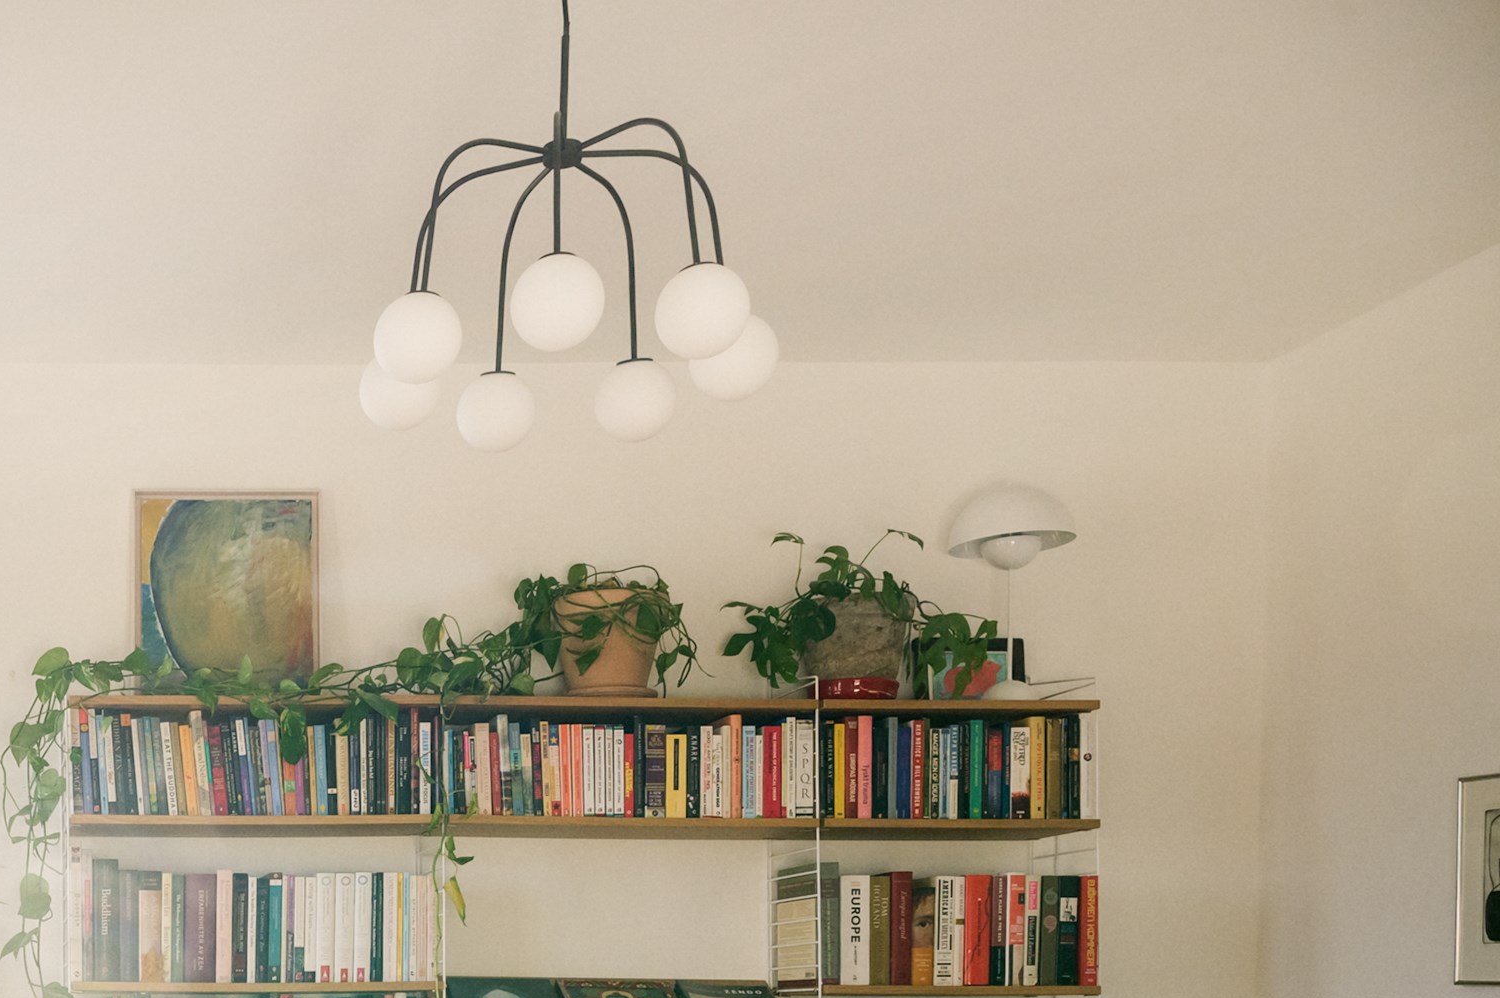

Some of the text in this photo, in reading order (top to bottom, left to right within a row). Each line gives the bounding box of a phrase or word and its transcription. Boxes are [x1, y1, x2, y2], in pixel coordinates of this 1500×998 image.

[690, 735, 698, 762] KNARK
[861, 764, 870, 782] Tyskt
[932, 773, 938, 782] OF
[167, 774, 176, 809] BUDDHA
[849, 778, 857, 803] MÖDRAR
[872, 884, 881, 929] HOLLAND
[881, 896, 889, 917] TOM
[898, 890, 907, 917] Europas
[941, 879, 949, 916] AMERICAN
[101, 888, 112, 936] Buddhism
[851, 888, 861, 943] EUROPE
[197, 889, 205, 971] ERFARENHETER AV ZEN
[724, 988, 763, 997] ZENDO
